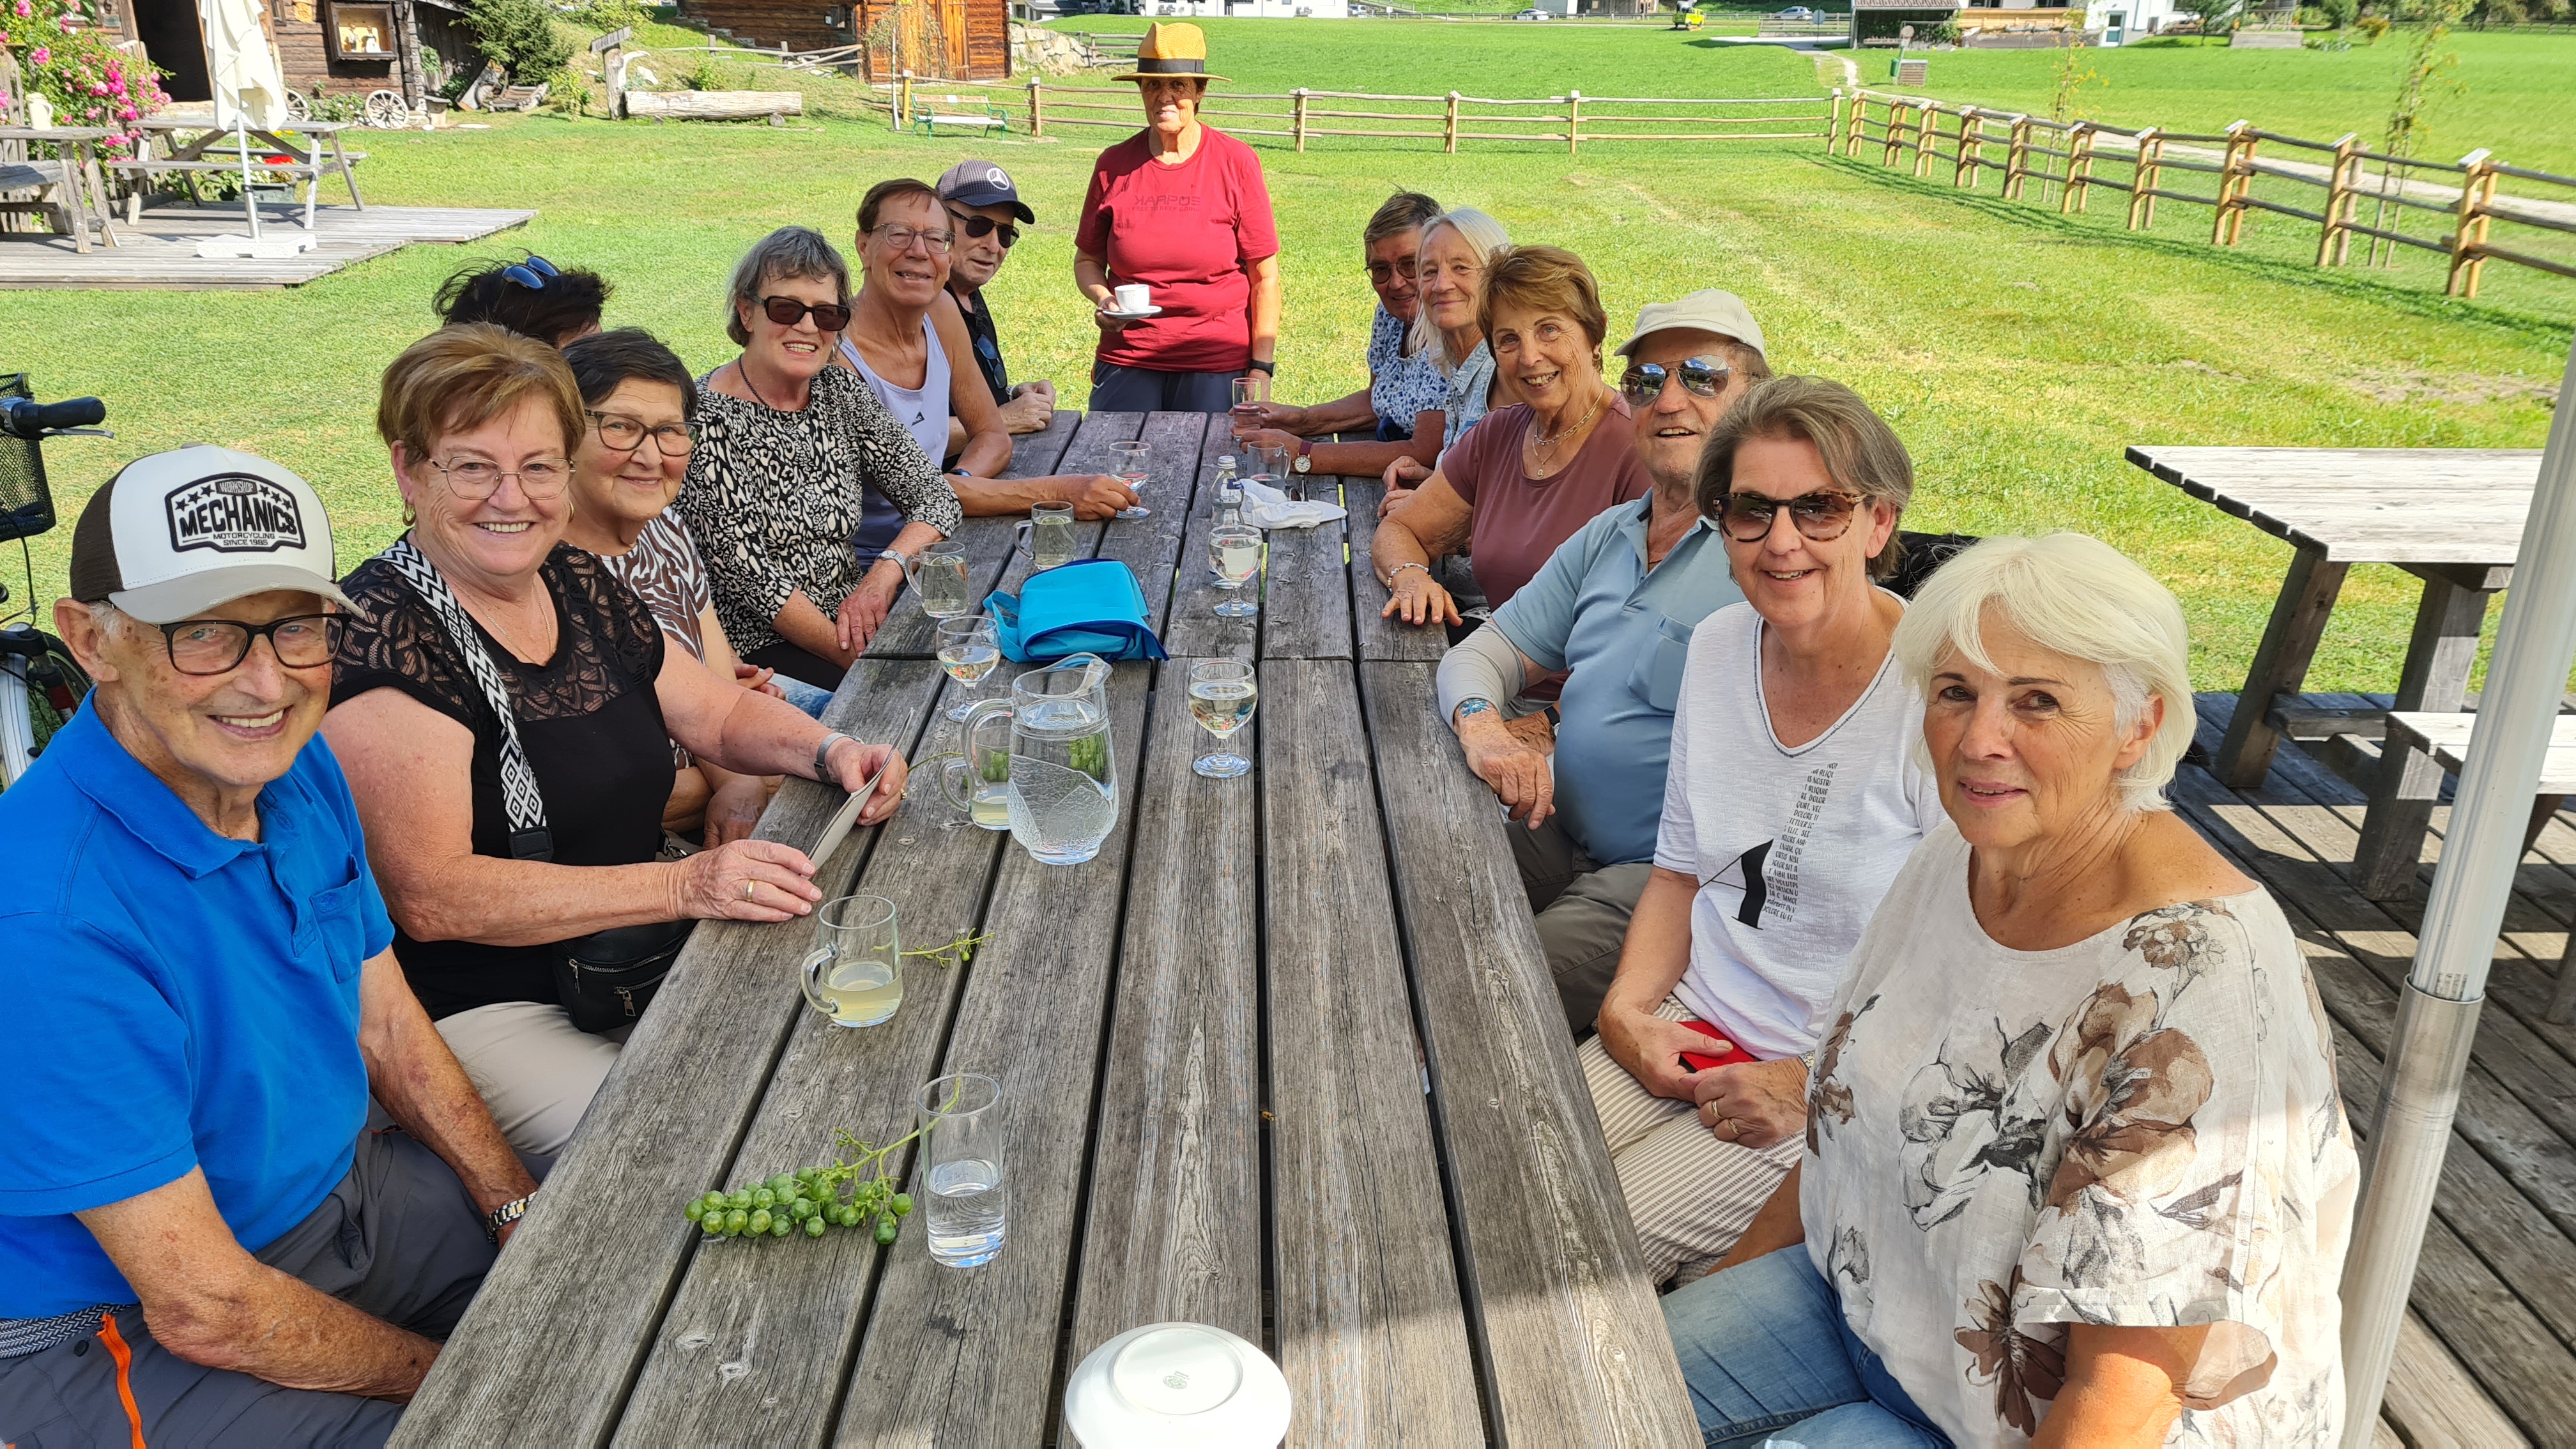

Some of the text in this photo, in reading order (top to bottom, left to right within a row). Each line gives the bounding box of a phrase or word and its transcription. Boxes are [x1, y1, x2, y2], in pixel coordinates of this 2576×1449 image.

[1135, 194, 1200, 206] KARPOS
[219, 480, 254, 493] WORKSHOP
[180, 494, 297, 537] MECHANICS
[1808, 794, 1826, 804] DOLOR
